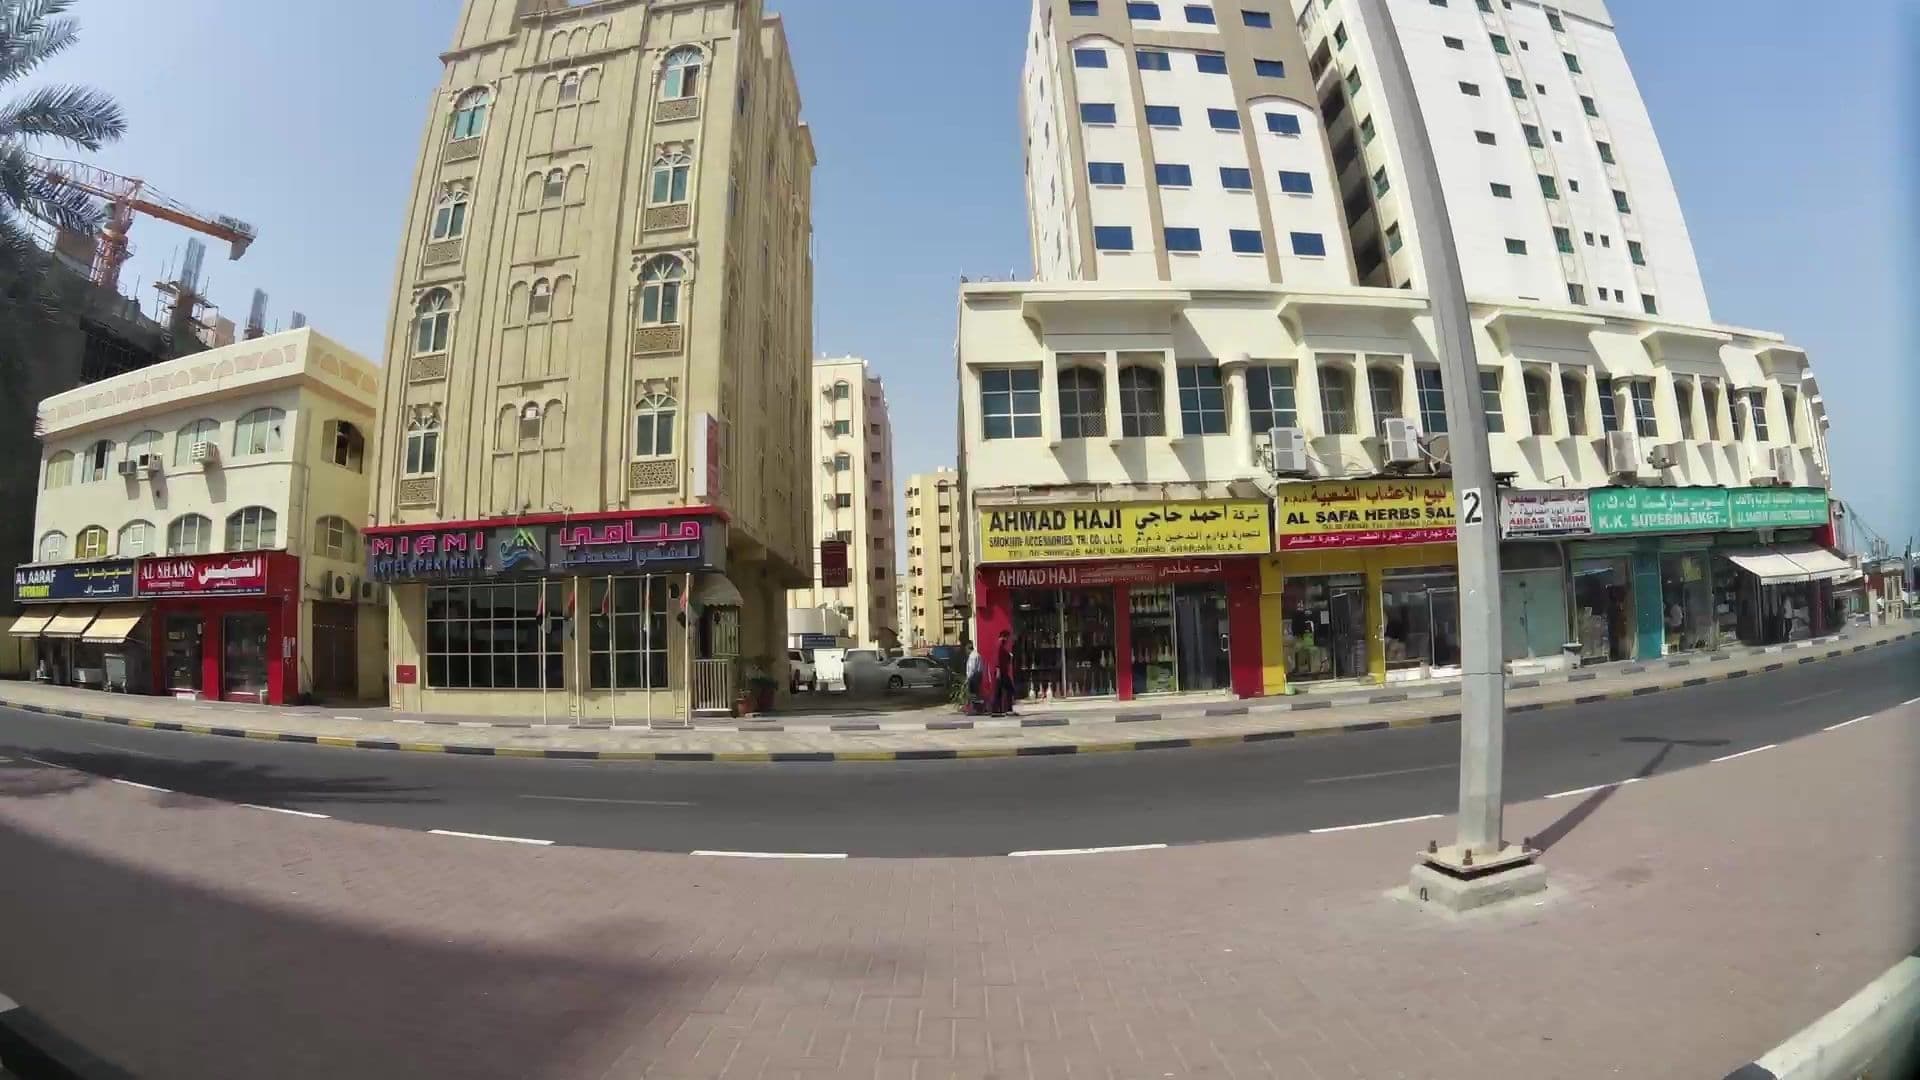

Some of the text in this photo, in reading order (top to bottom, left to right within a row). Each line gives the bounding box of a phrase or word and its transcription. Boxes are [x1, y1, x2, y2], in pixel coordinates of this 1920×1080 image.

[1287, 507, 1455, 524] AL SAFA HERBS SAL
[1463, 491, 1482, 524] 2
[989, 508, 1122, 531] AHMAD HAJI
[371, 531, 484, 556] MIAMI
[16, 569, 56, 584] AL AARAF
[158, 559, 195, 578] SHAMS
[998, 569, 1047, 587] AHMAD
[1048, 567, 1077, 584] HAJI
